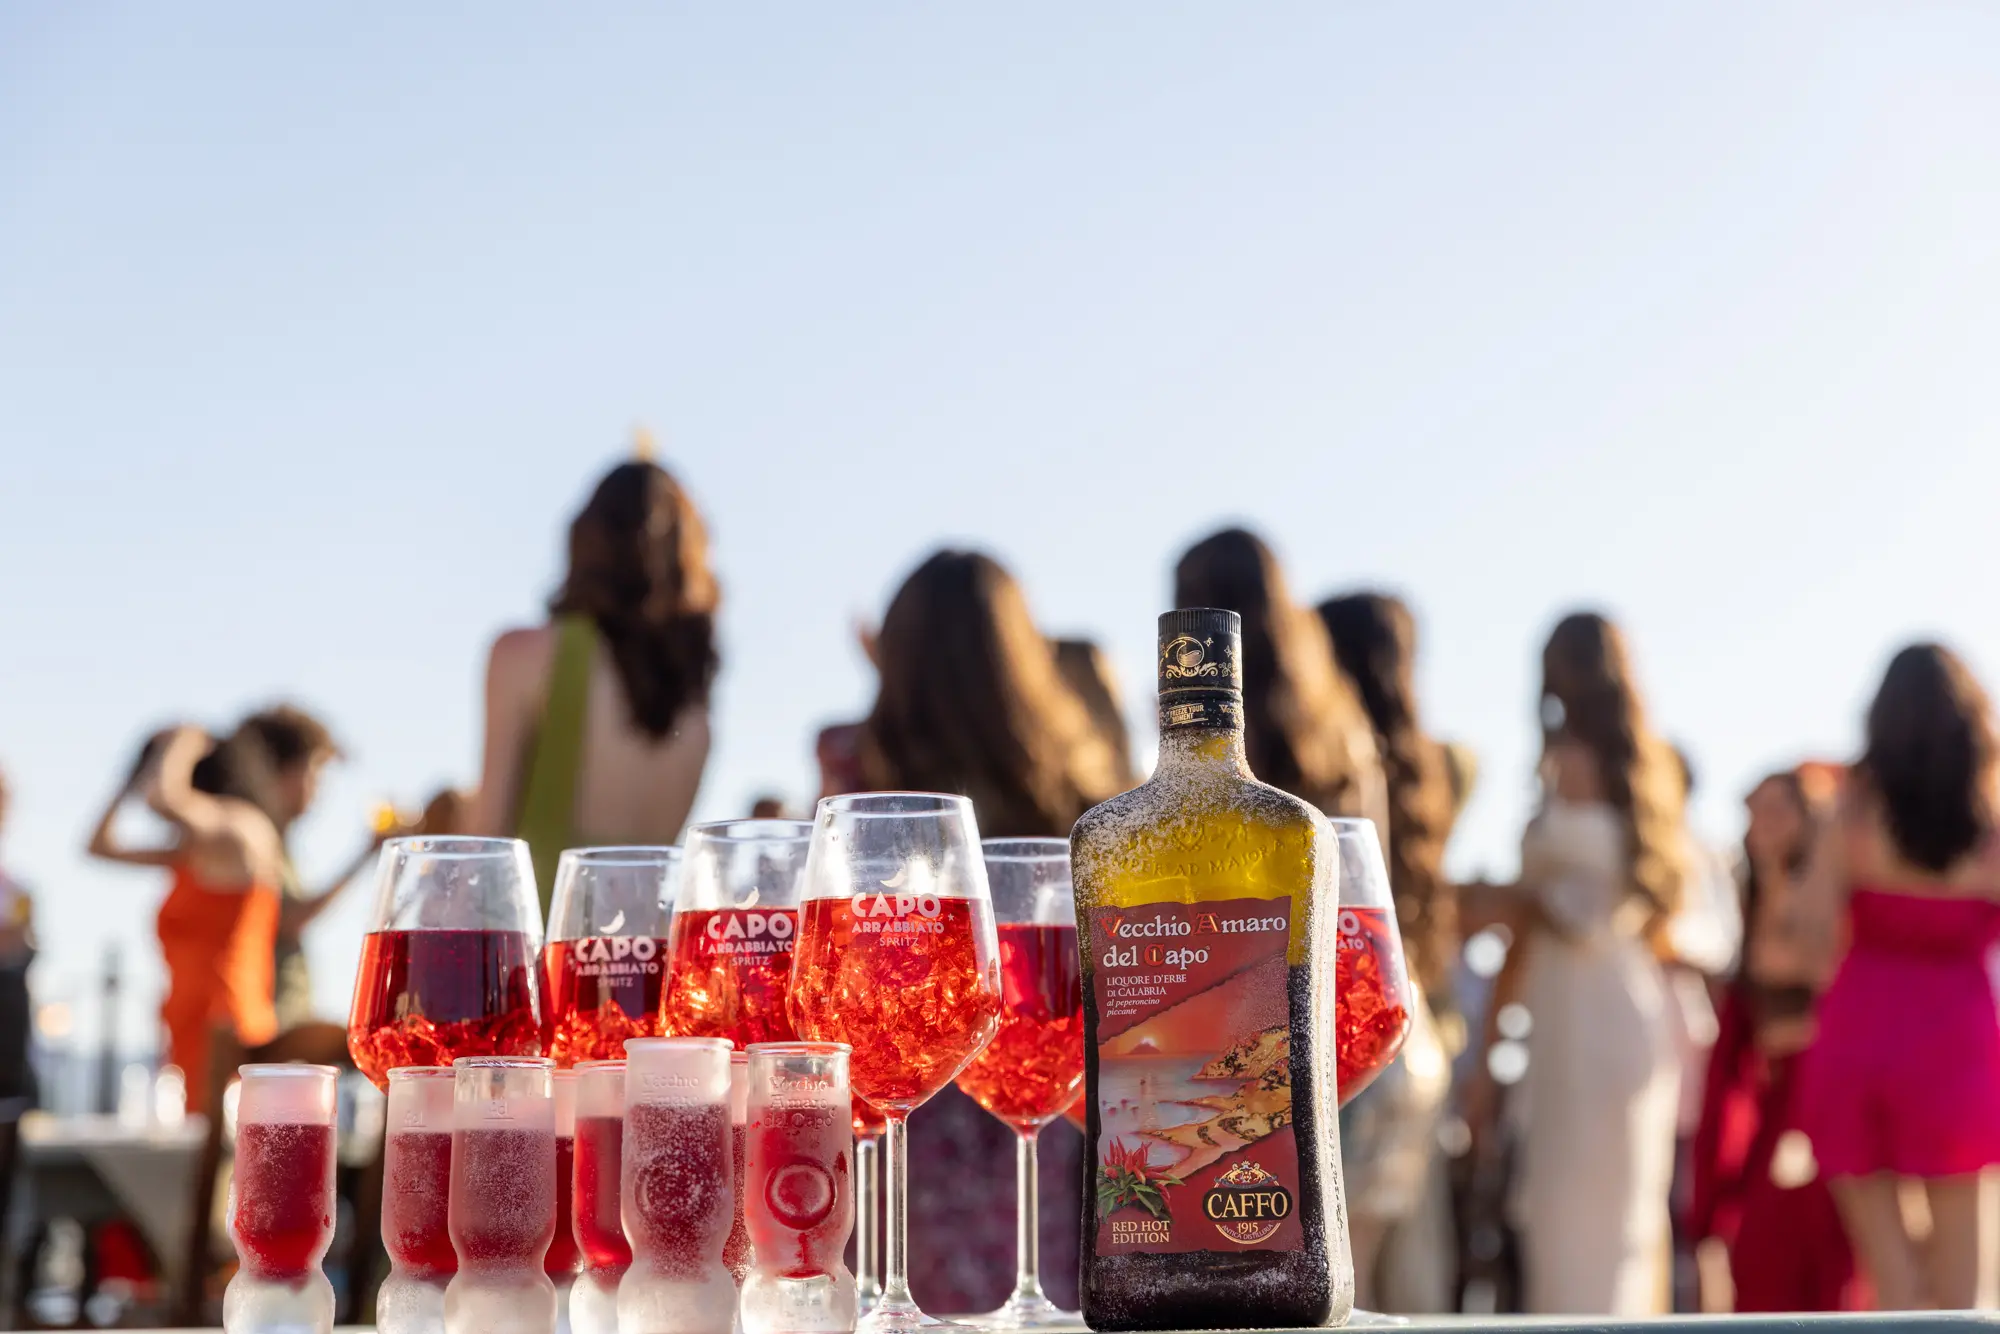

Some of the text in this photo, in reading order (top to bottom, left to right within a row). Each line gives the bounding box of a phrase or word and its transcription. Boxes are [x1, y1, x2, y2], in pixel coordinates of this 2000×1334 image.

[1188, 704, 1205, 713] YOUR
[851, 891, 942, 918] CAPO
[707, 912, 793, 939] CAPO
[852, 921, 945, 934] ARRABBIATO
[1100, 912, 1287, 938] Vecchio Amaro
[707, 940, 793, 955] ARRABBIATO
[879, 936, 919, 947] SPRITZ
[575, 936, 656, 962] CAPO
[732, 956, 770, 966] SPRITZ
[1103, 943, 1209, 970] del Capo
[1106, 974, 1187, 987] LIQUORE D'ERBE
[1107, 986, 1167, 998] DI CALABRIA
[1106, 998, 1160, 1008] al peperoncino
[1106, 1008, 1138, 1018] piccante
[770, 1093, 829, 1110] Amaro
[1207, 1191, 1288, 1219] CAFFO
[1112, 1220, 1170, 1232] RED HOT
[1221, 1223, 1274, 1240] ANTICA DISTILLERIA
[1236, 1221, 1259, 1235] 1915
[1112, 1232, 1170, 1244] EDITION
